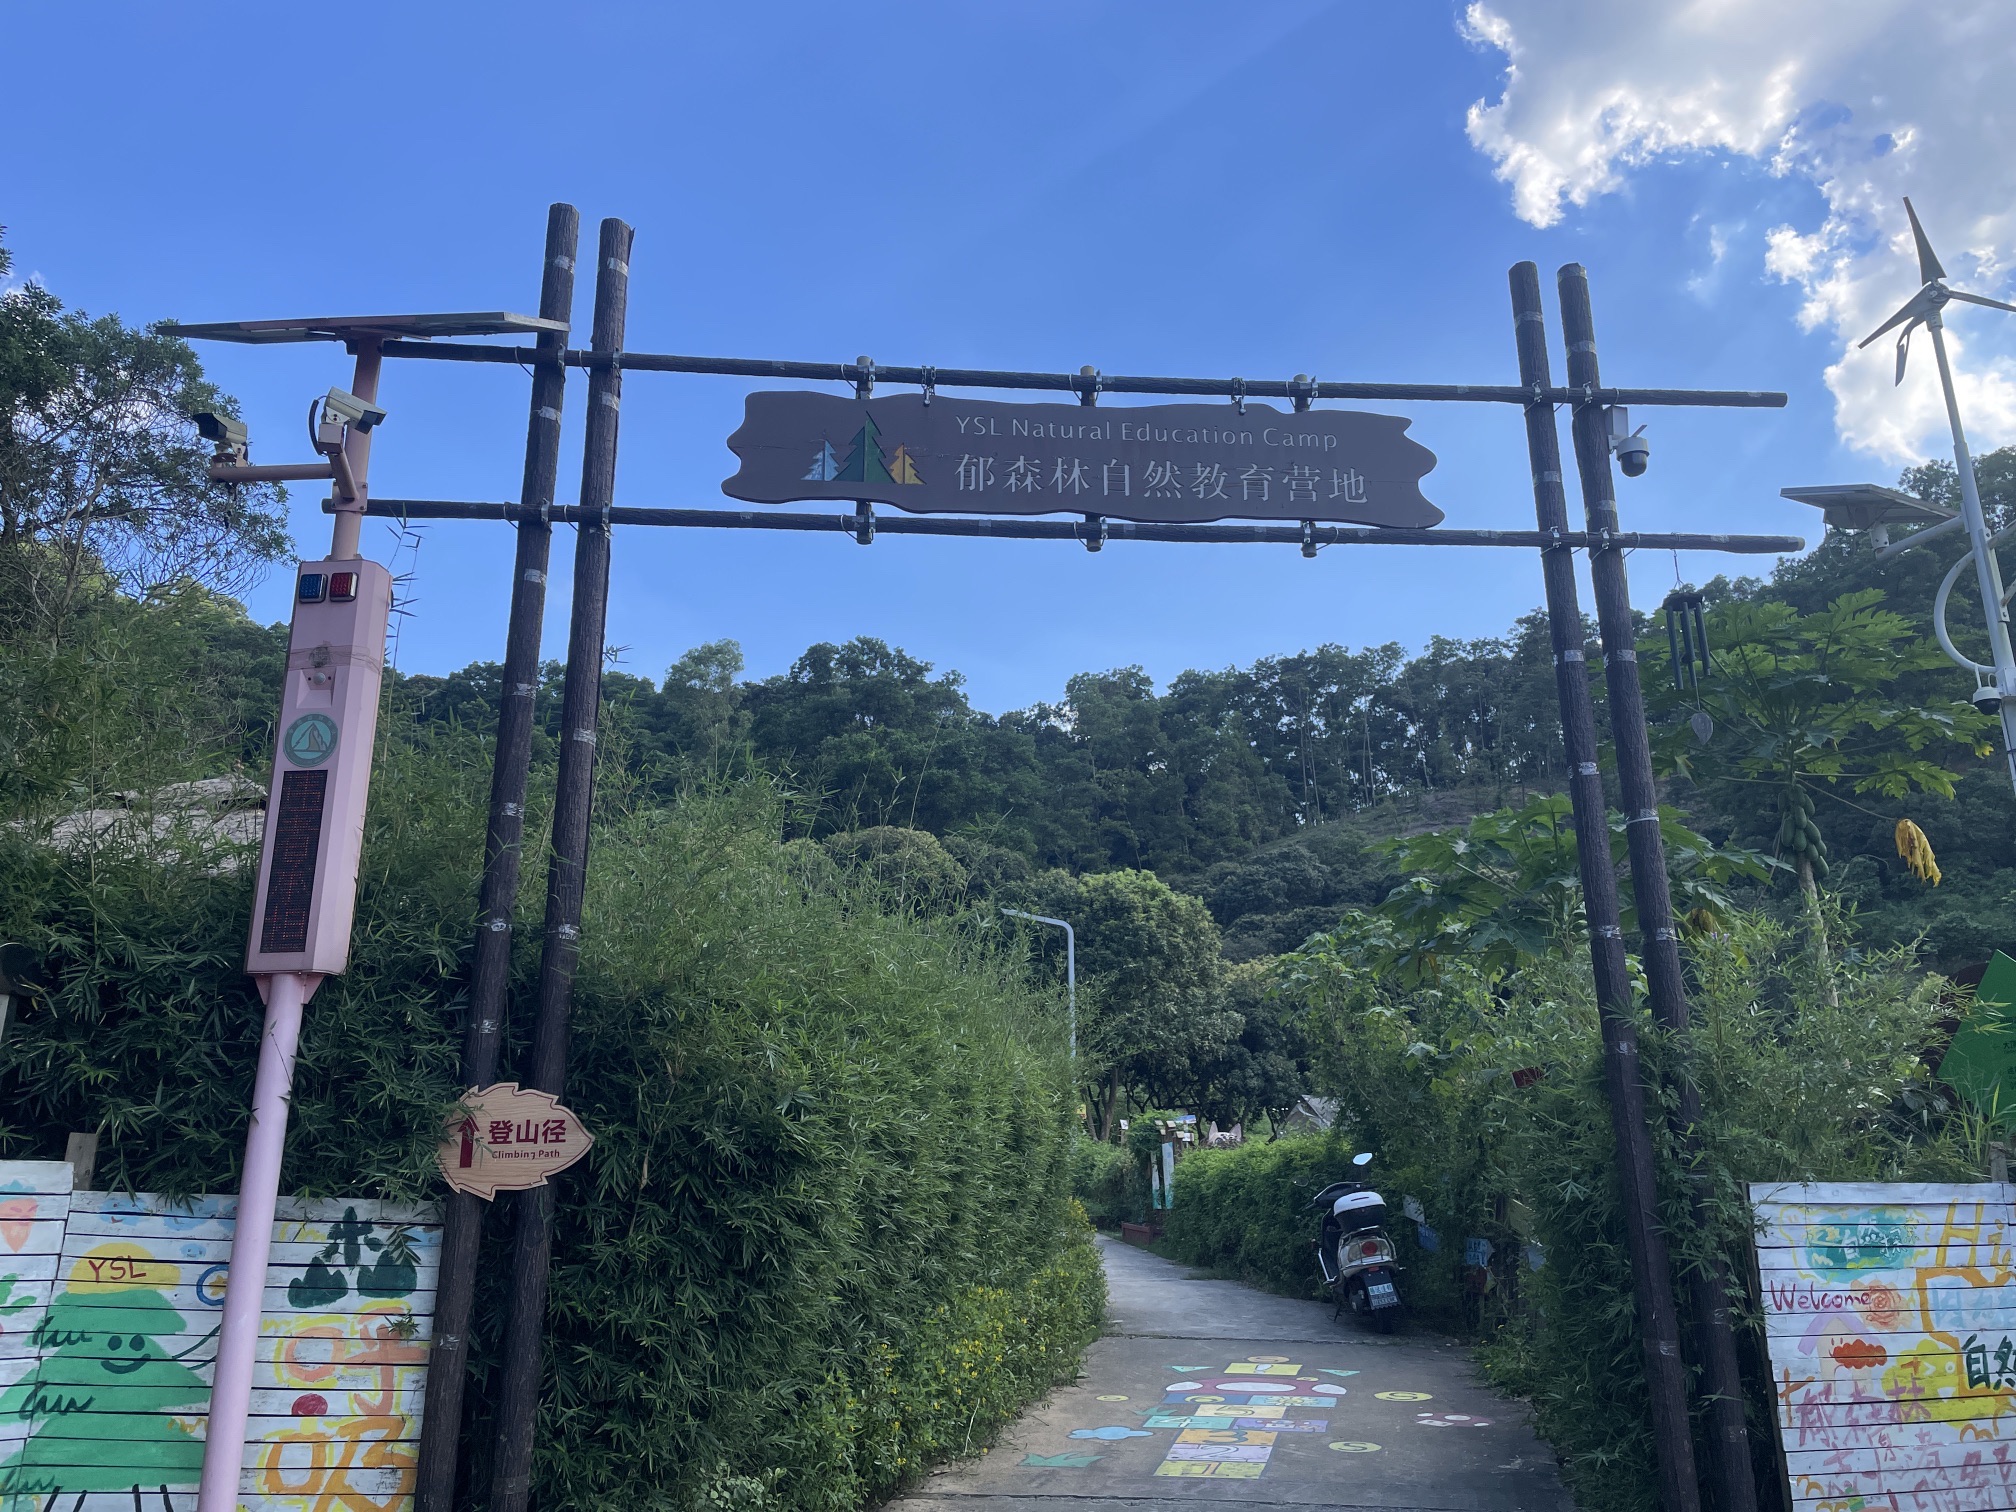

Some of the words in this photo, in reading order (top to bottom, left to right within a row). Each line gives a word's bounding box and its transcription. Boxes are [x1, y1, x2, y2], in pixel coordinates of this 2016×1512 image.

[956, 416, 1002, 436] YSL
[1012, 418, 1110, 440] Natural
[1122, 422, 1253, 445] Education
[1263, 427, 1338, 451] Camp
[954, 454, 1368, 504] 郁森林自然教育营地
[487, 1119, 567, 1145] 登山径
[491, 1150, 536, 1160] Climbing
[538, 1149, 560, 1158] Path
[88, 1255, 147, 1283] YSL
[1770, 1280, 1872, 1312] Welcome
[1213, 1405, 1255, 1416] 5
[1155, 1416, 1210, 1428] 4
[1202, 1429, 1250, 1443] 3
[1190, 1445, 1248, 1461] 2
